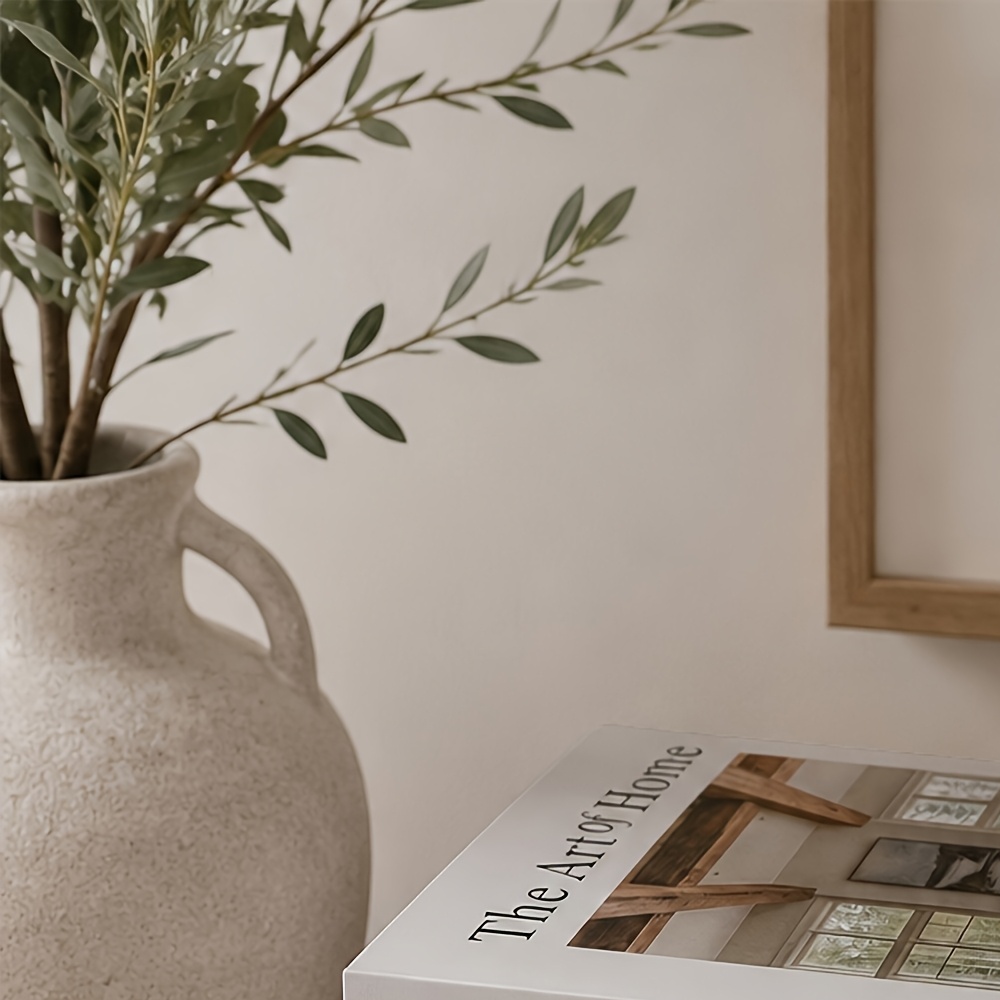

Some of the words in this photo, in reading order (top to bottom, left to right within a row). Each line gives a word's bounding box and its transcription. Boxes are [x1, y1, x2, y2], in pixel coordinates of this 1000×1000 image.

[592, 745, 704, 813] Home
[577, 810, 634, 834] of
[535, 835, 618, 882] Art
[467, 886, 569, 943] The
